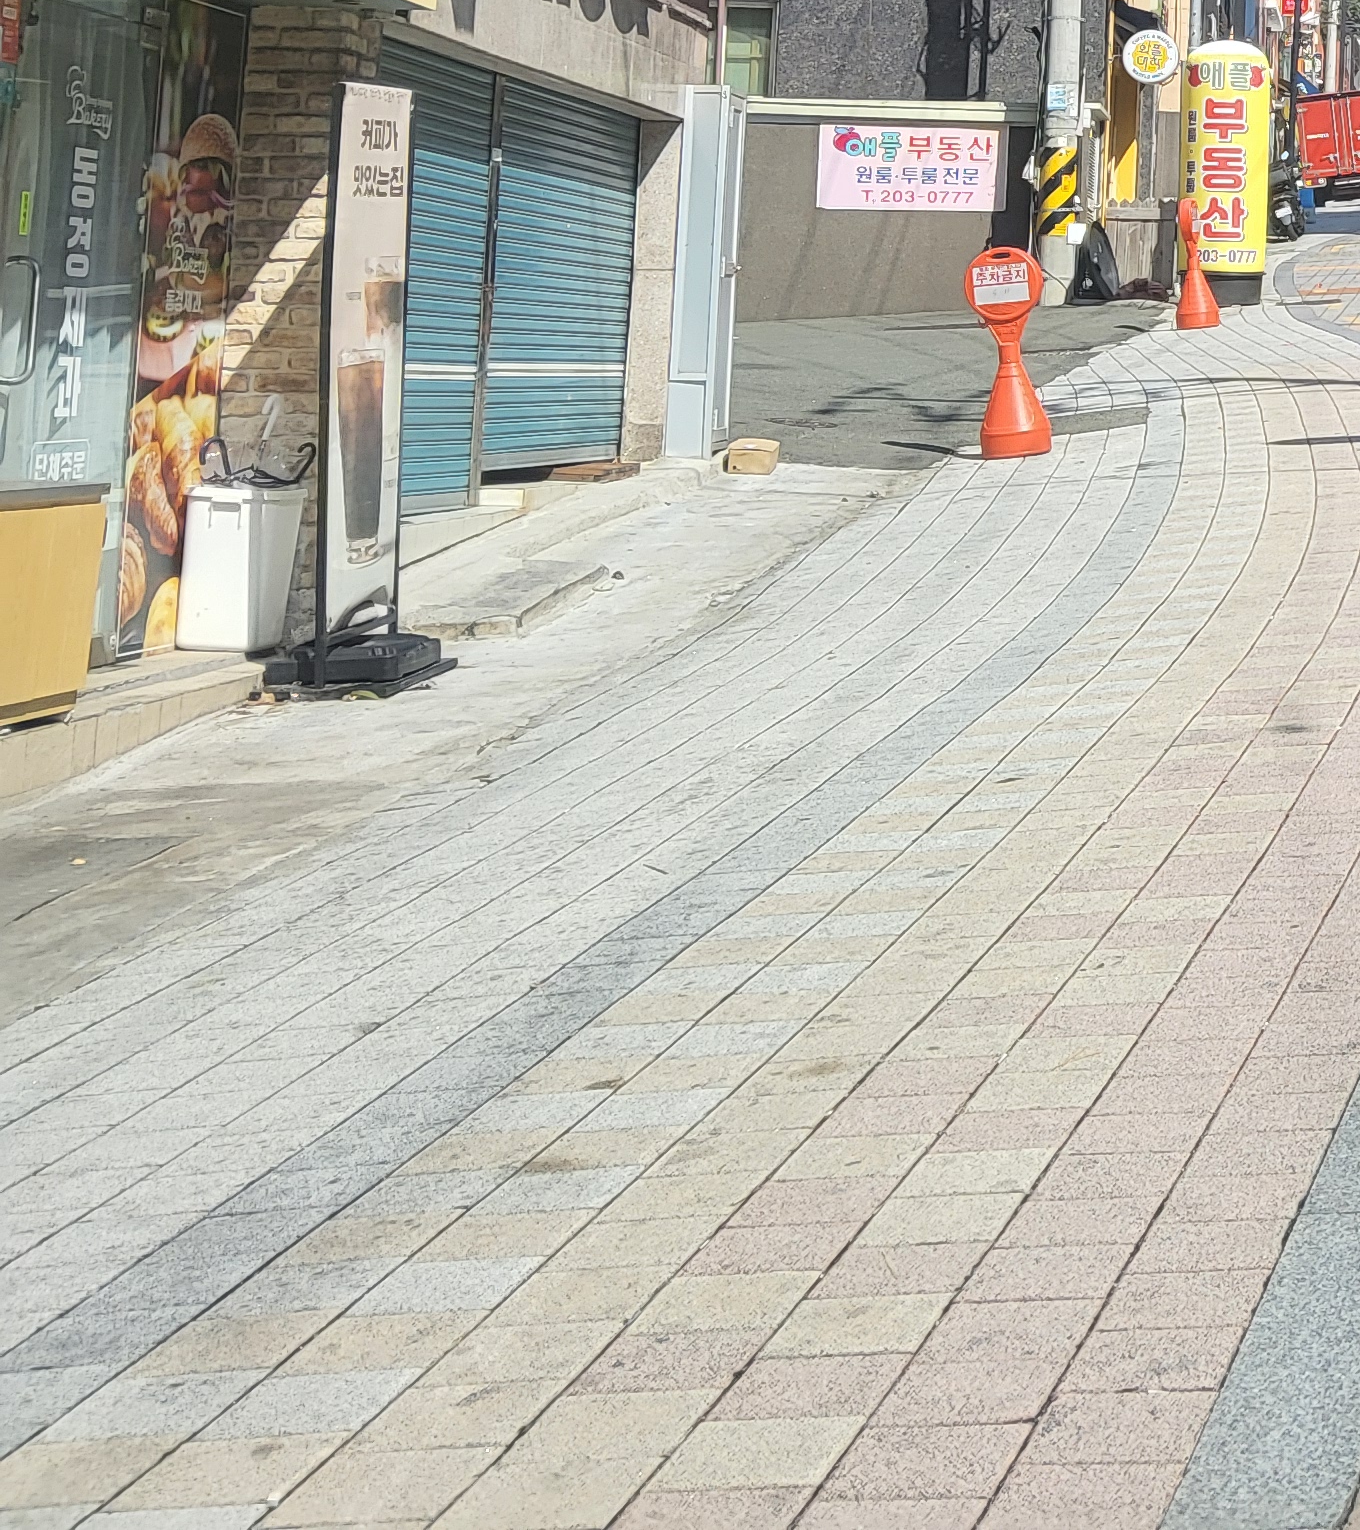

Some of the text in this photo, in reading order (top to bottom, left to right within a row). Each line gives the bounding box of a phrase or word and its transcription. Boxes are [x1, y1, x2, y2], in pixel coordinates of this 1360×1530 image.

[1200, 61, 1250, 90] 애플
[361, 118, 399, 152] 커피가
[845, 131, 994, 162] 애플 부동산
[352, 165, 404, 198] 맛있는집
[856, 165, 980, 185] 원룸·투룸 전문
[1200, 97, 1246, 240] 부동산
[880, 190, 974, 204] 203-0777
[1197, 250, 1257, 264] 203-0777
[54, 146, 99, 418] 동경제과
[975, 268, 1027, 285] 주차금지
[34, 450, 86, 482] 단체주문
